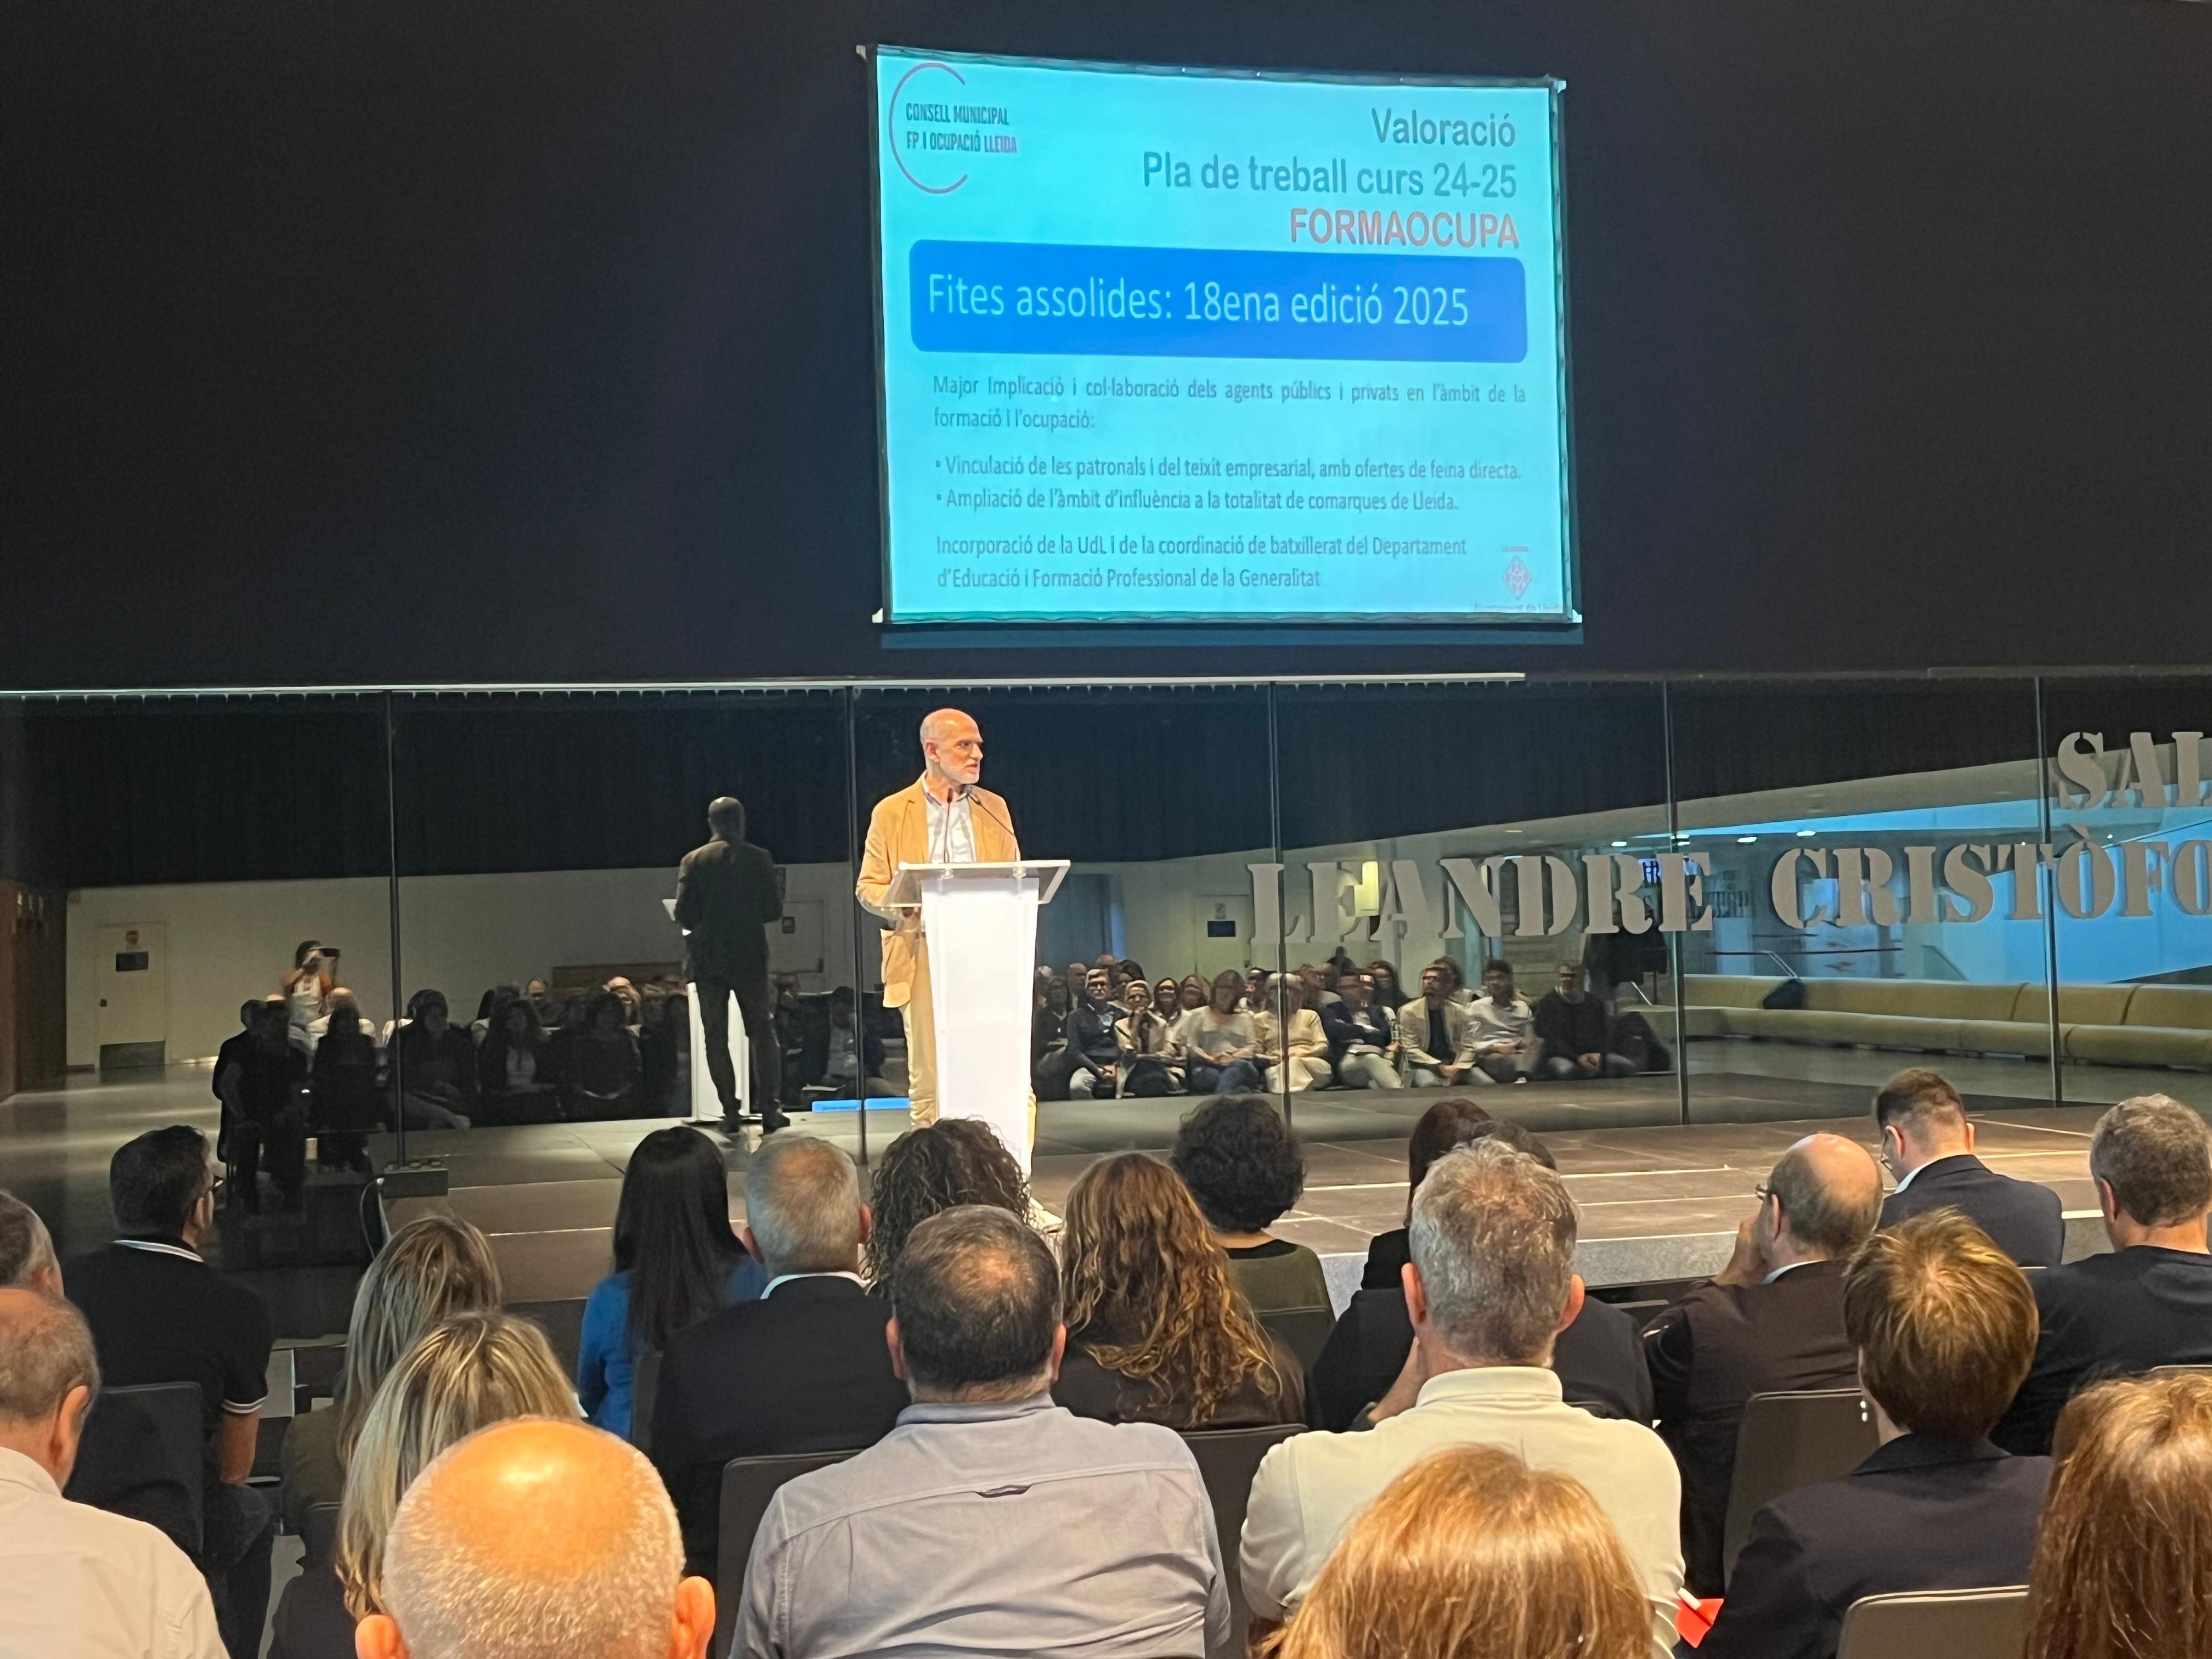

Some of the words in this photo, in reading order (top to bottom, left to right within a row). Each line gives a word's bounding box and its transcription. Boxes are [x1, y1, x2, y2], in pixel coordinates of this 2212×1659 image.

[906, 103, 950, 123] CONSELL
[953, 105, 1009, 125] MUNICIPAL
[1371, 107, 1516, 147] Valoració
[906, 131, 919, 149] FP
[930, 129, 981, 152] OCUPACIÓ
[984, 136, 1017, 153] LLEIDA
[1143, 151, 1191, 188] Pla
[1200, 154, 1239, 190] de
[1249, 155, 1347, 194] treball
[1357, 168, 1423, 195] curs
[1434, 162, 1517, 198] 24-25
[1290, 207, 1519, 249] FORMAOCUPA
[929, 274, 1005, 315] Fites
[1016, 276, 1171, 319] assolides:
[1184, 281, 1279, 321] 18ena
[1291, 282, 1383, 324] edició
[1393, 286, 1468, 326] 2025
[933, 375, 979, 399] Major
[1188, 380, 1217, 398] dels
[1225, 383, 1273, 403] agents
[1281, 381, 1331, 404] públics
[1352, 383, 1399, 404] privats
[1407, 387, 1424, 401] en
[1488, 384, 1505, 402] de
[1514, 384, 1526, 402] la
[934, 407, 1002, 427] formació
[945, 455, 1024, 475] Vinculació
[1029, 456, 1046, 475] de
[1052, 456, 1071, 475] les
[1077, 455, 1146, 479] patronals
[1158, 457, 1180, 476] del
[1226, 458, 1315, 480] empresarial,
[1319, 459, 1350, 477] amb
[1355, 459, 1405, 478] ofertes
[1409, 460, 1426, 478] de
[946, 487, 1022, 511] Ampliació
[1027, 488, 1045, 508] de
[1208, 489, 1220, 509] la
[1224, 489, 1283, 510] totalitat
[1286, 490, 1304, 509] de
[1308, 491, 1387, 513] comarques
[1391, 492, 1408, 510] de
[937, 535, 1032, 558] Incorporació
[1037, 535, 1056, 554] de
[1061, 535, 1073, 554] la
[1119, 535, 1137, 554] de
[1142, 535, 1153, 554] la
[1159, 535, 1244, 554] coordinació
[1248, 535, 1266, 554] de
[1271, 535, 1342, 555] batxillerat
[1346, 535, 1367, 554] del
[1373, 537, 1466, 558] Departament
[1033, 567, 1102, 587] Formació
[1108, 568, 1196, 587] Professional
[1200, 568, 1218, 586] de
[1223, 567, 1234, 586] la
[1240, 568, 1320, 587] Generalitat
[1247, 852, 1713, 944] LEANDRE
